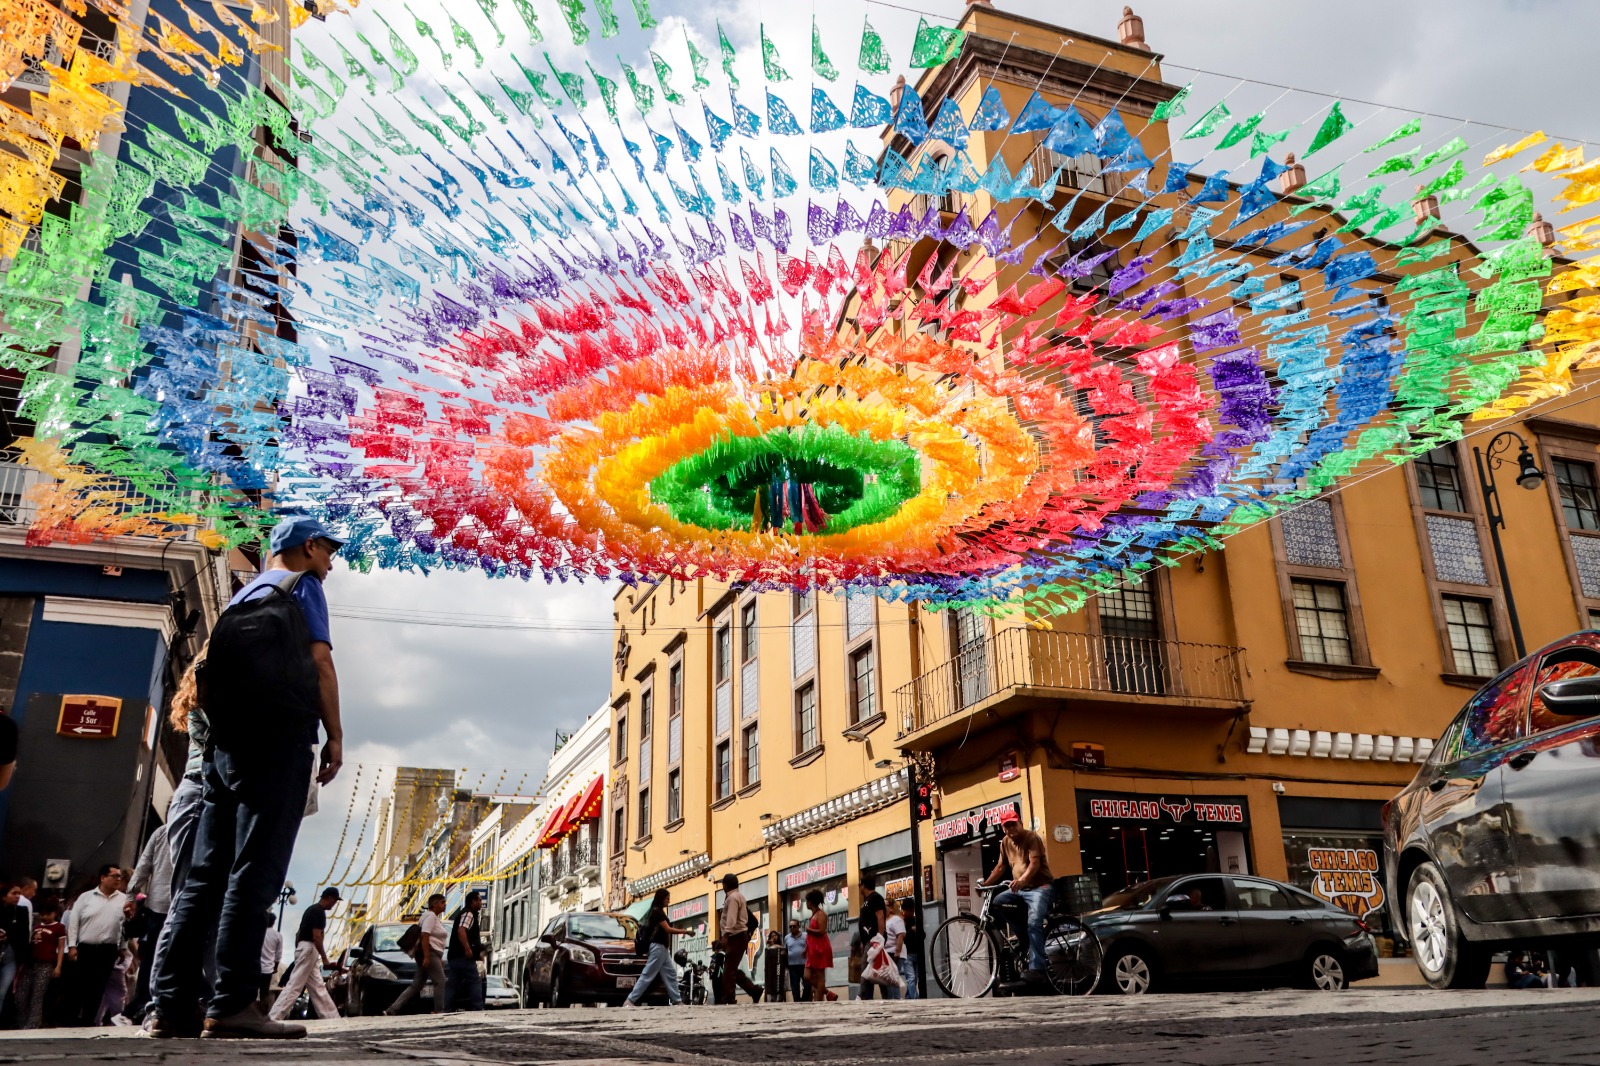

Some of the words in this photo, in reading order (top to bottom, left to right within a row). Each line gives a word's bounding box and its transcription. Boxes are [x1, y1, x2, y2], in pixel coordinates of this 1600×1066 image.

[1089, 800, 1159, 819] CHICAGO
[1194, 803, 1243, 822] TENIS
[933, 816, 967, 842] CHICAGO
[1309, 849, 1378, 871] CHICAGO
[1320, 871, 1373, 893] TENIS
